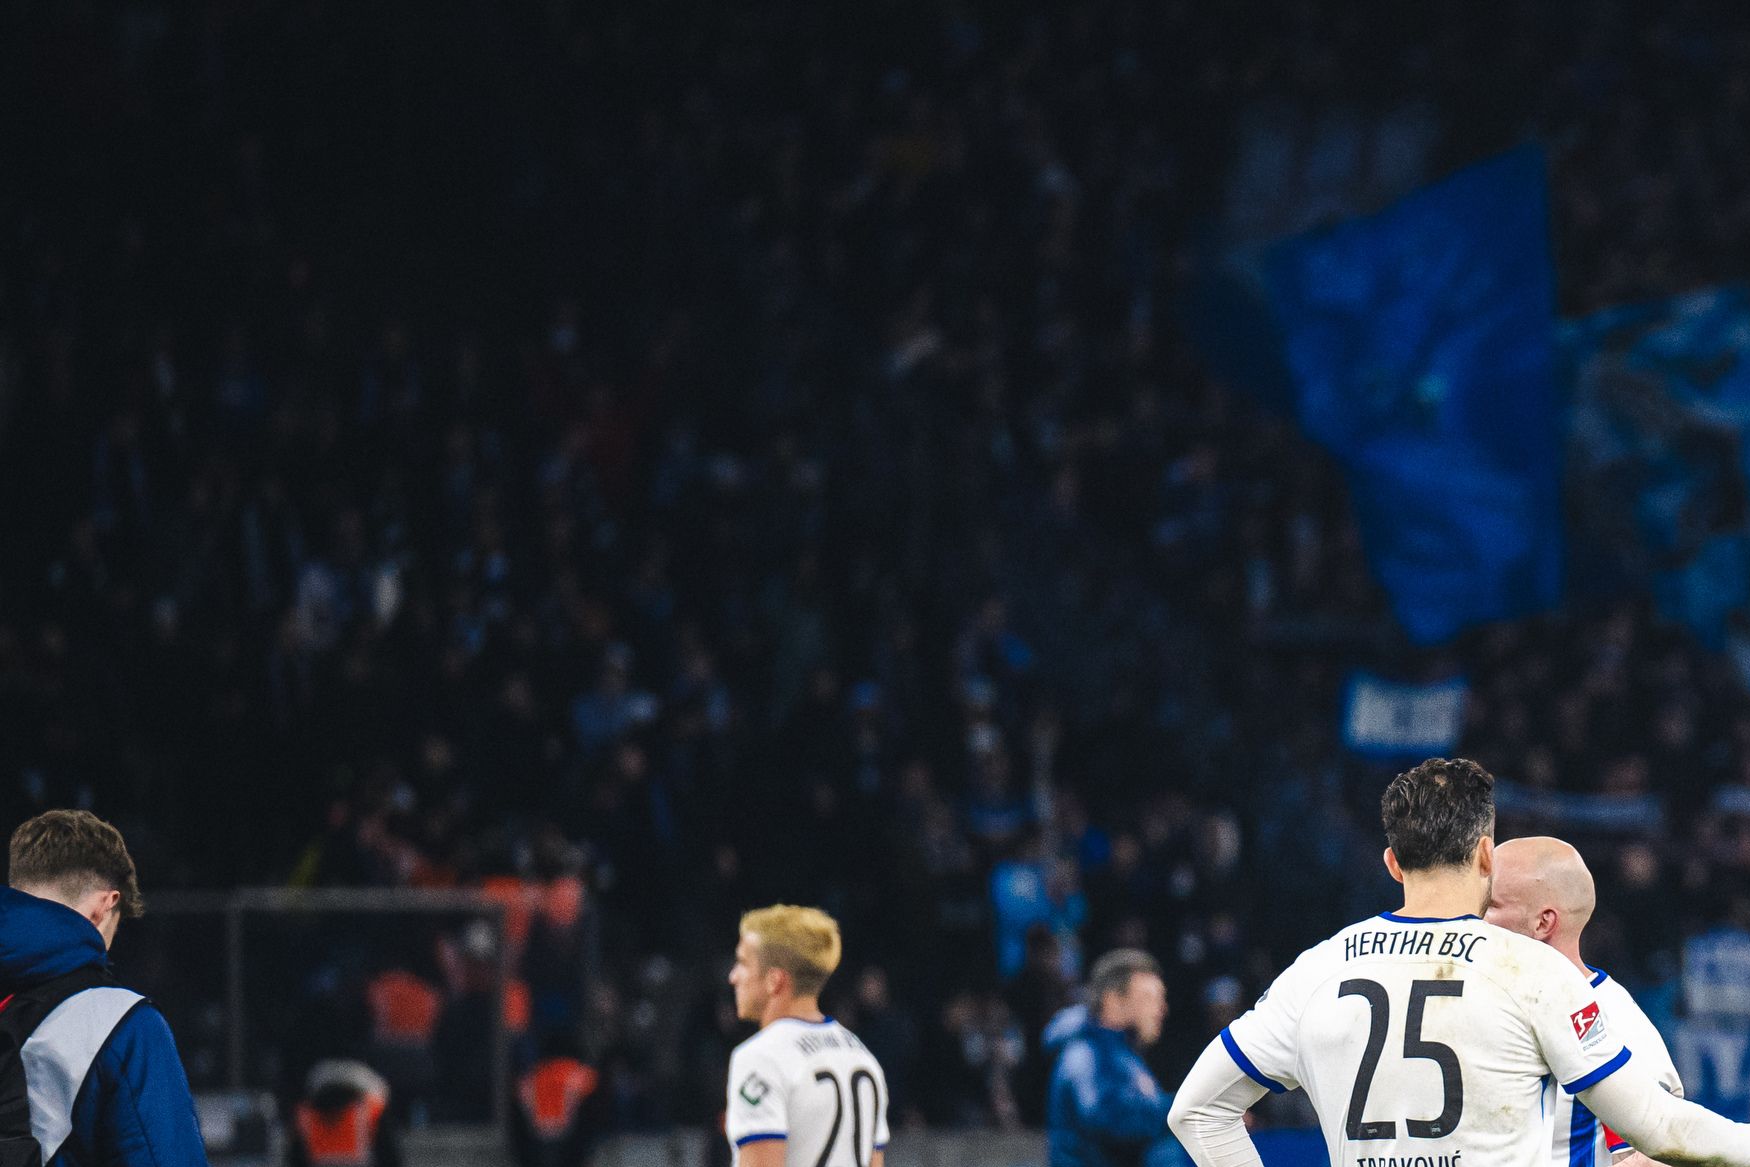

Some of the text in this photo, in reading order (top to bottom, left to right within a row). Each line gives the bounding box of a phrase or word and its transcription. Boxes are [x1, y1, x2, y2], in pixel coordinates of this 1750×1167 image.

[1344, 930, 1487, 963] HERTHA BSC
[1338, 978, 1465, 1141] 25
